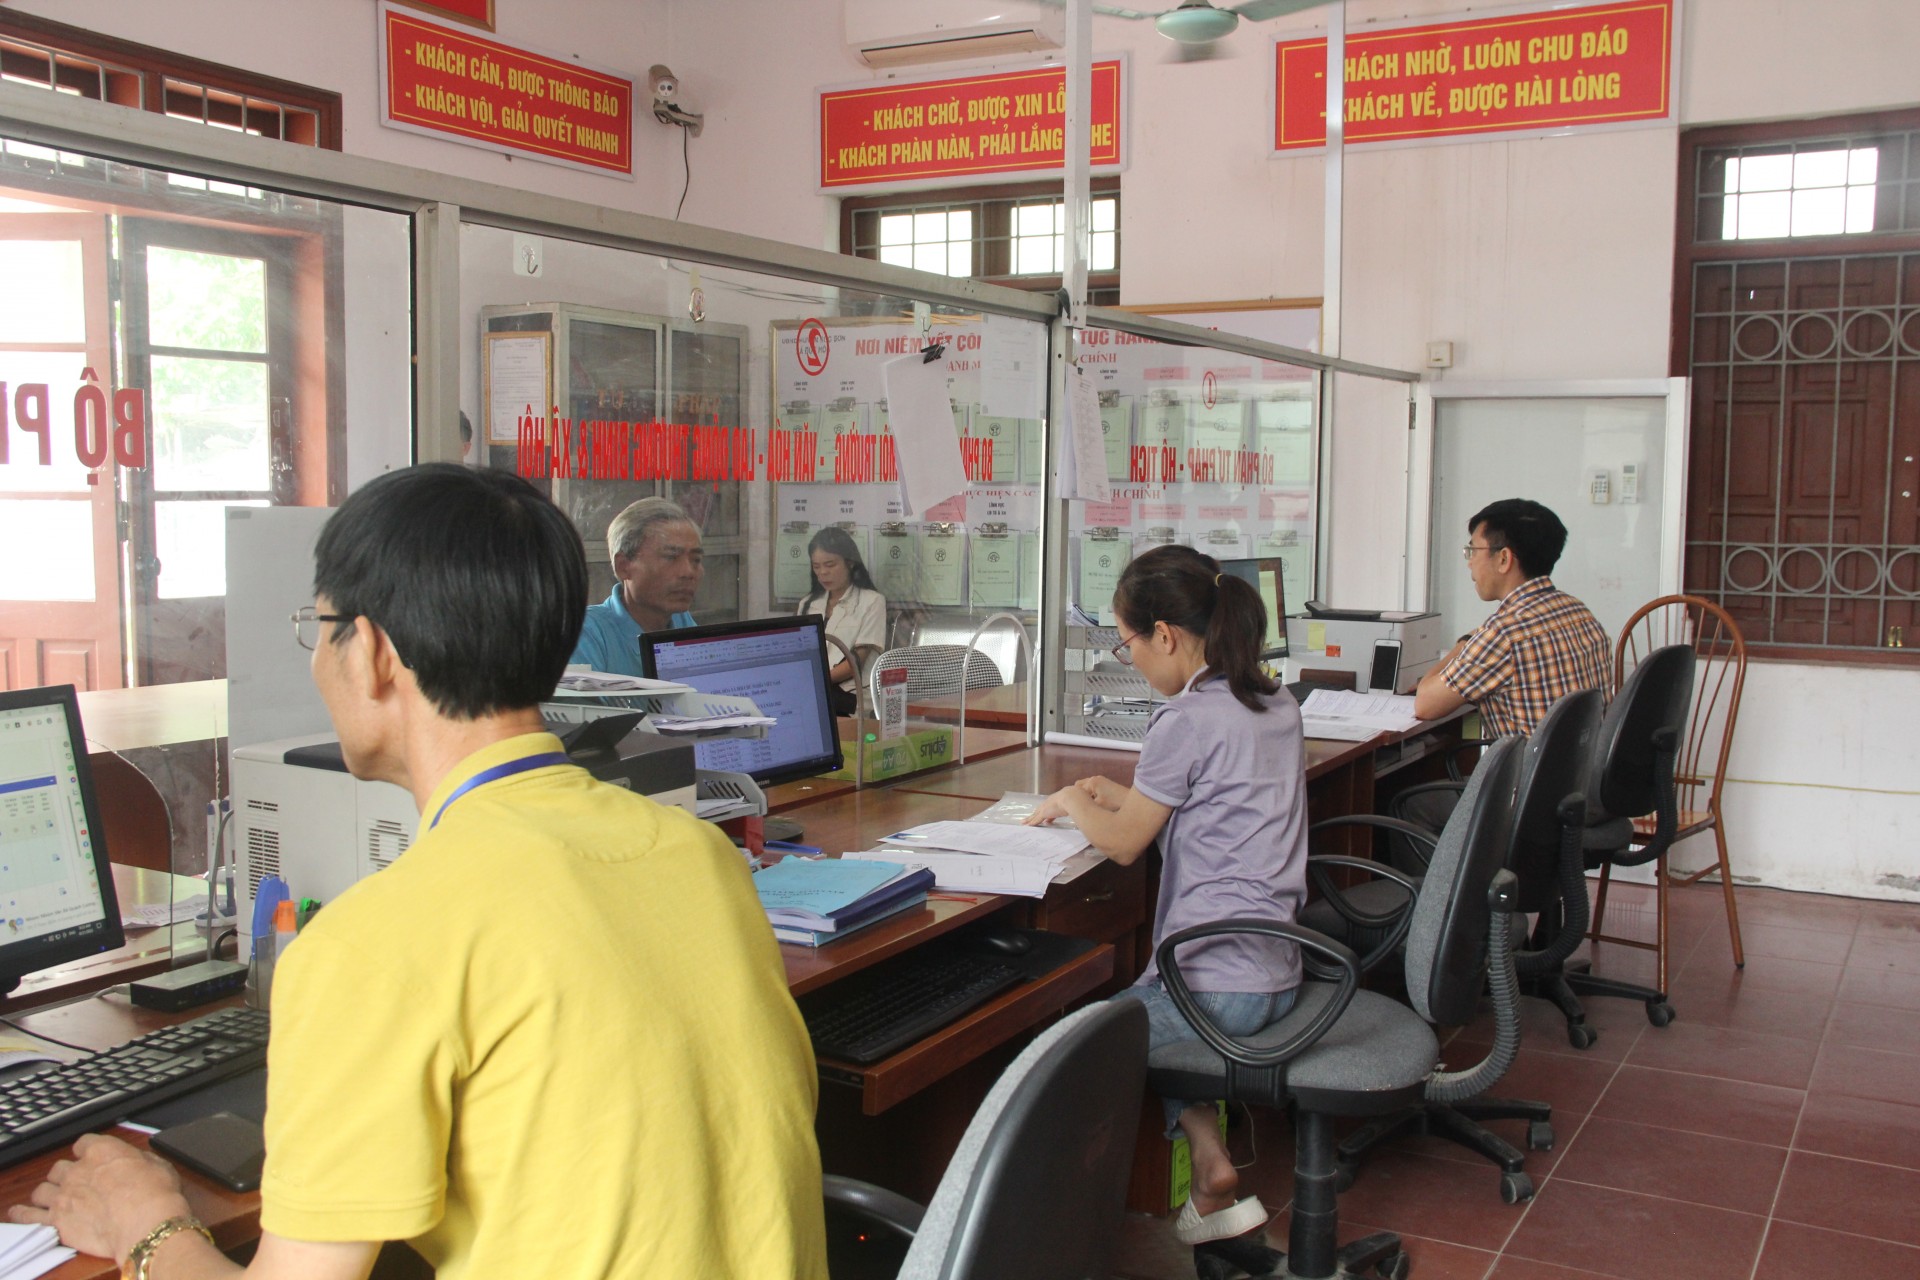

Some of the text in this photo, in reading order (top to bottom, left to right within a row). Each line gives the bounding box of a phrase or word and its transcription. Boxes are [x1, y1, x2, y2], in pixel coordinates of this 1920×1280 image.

[1406, 46, 1456, 77] NHỜ,
[1464, 37, 1520, 71] LUÔN
[1528, 33, 1573, 65] CHU
[1580, 25, 1628, 59] ĐÁO
[416, 42, 466, 77] KHÁCH
[470, 53, 504, 89] CẦN,
[508, 67, 545, 99] ĐƯỢC
[549, 79, 590, 112] THÔNG
[593, 89, 618, 118] BÁO
[1410, 81, 1442, 119] VỀ,
[1449, 82, 1507, 118] ĐƯỢC
[1515, 74, 1552, 109] HÀI
[1560, 69, 1620, 104] LÒNG
[416, 84, 466, 118] KHÁCH
[470, 98, 498, 129] VỘI,
[501, 101, 529, 133] GIẢI
[533, 114, 573, 144] QUYẾT
[576, 125, 618, 155] NHANH
[873, 103, 924, 131] KHÁCH
[928, 96, 963, 126] CHỜ,
[968, 95, 1010, 124] ĐƯỢC
[1015, 92, 1042, 116] XIN
[1048, 82, 1065, 114] LỖ
[839, 142, 887, 169] KHÁCH
[891, 134, 932, 164] PHÀN
[937, 134, 974, 161] NÀN,
[979, 124, 1016, 157] PHẢI
[1021, 122, 1063, 153] LẮNG
[1080, 330, 1110, 347] TỤC
[1080, 351, 1117, 363] CHÍNH
[1123, 486, 1160, 499] CHÍNH
